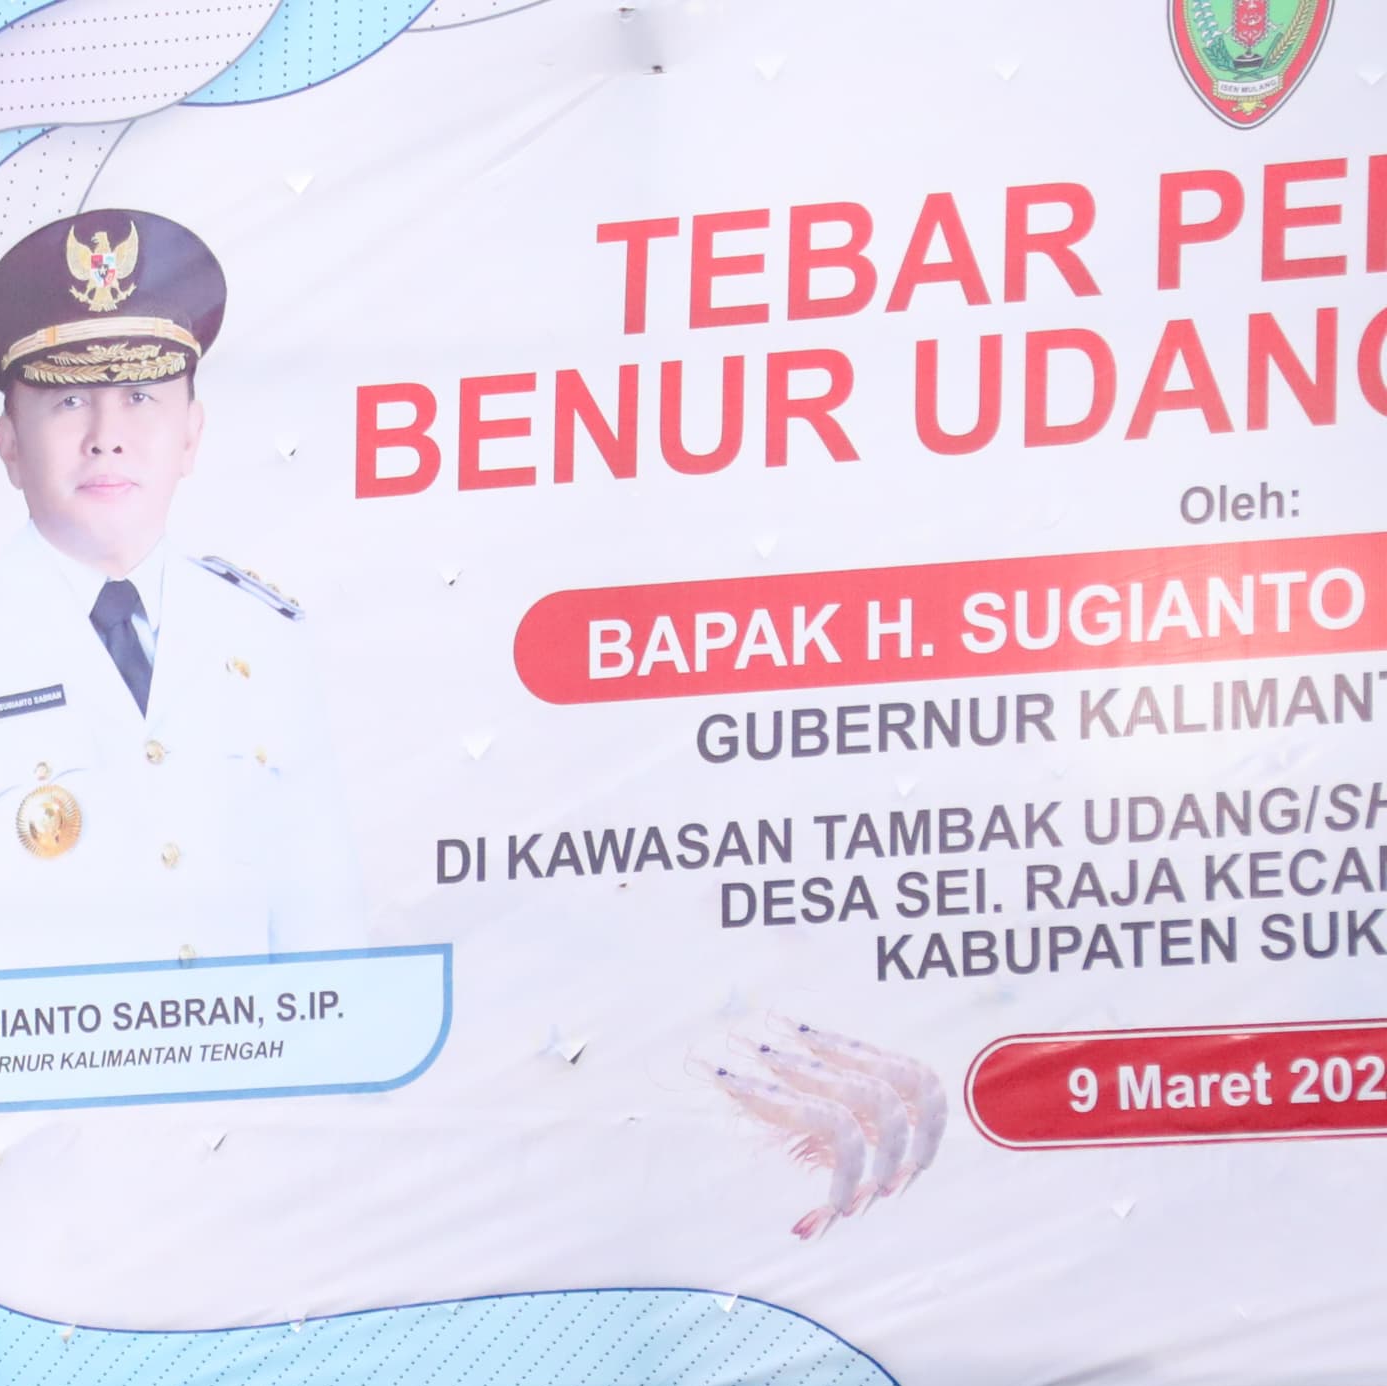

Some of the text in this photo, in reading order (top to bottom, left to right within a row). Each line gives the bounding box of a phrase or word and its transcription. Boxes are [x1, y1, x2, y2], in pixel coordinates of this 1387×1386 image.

[597, 155, 1387, 334] TEBAR PE
[356, 308, 1387, 498] BENUR UDAN
[1180, 482, 1299, 524] Oleh:
[589, 568, 1365, 679] BAPAK H. SUGIANTO
[697, 671, 1387, 763] GUBERNUR KALIMAN
[437, 837, 485, 884] DI
[508, 818, 791, 880] KAWASAN
[814, 802, 1062, 860] TAMBAK
[722, 845, 1387, 928] DESA SEI. RAJA KECA
[877, 917, 1236, 981] KABUPATEN
[113, 996, 263, 1030] SABRAN,
[277, 991, 343, 1021] S.IP.
[60, 1046, 192, 1069] KALIMANTAN
[200, 1041, 283, 1062] TENGAH
[1068, 1055, 1386, 1114] 9 Maret 202
